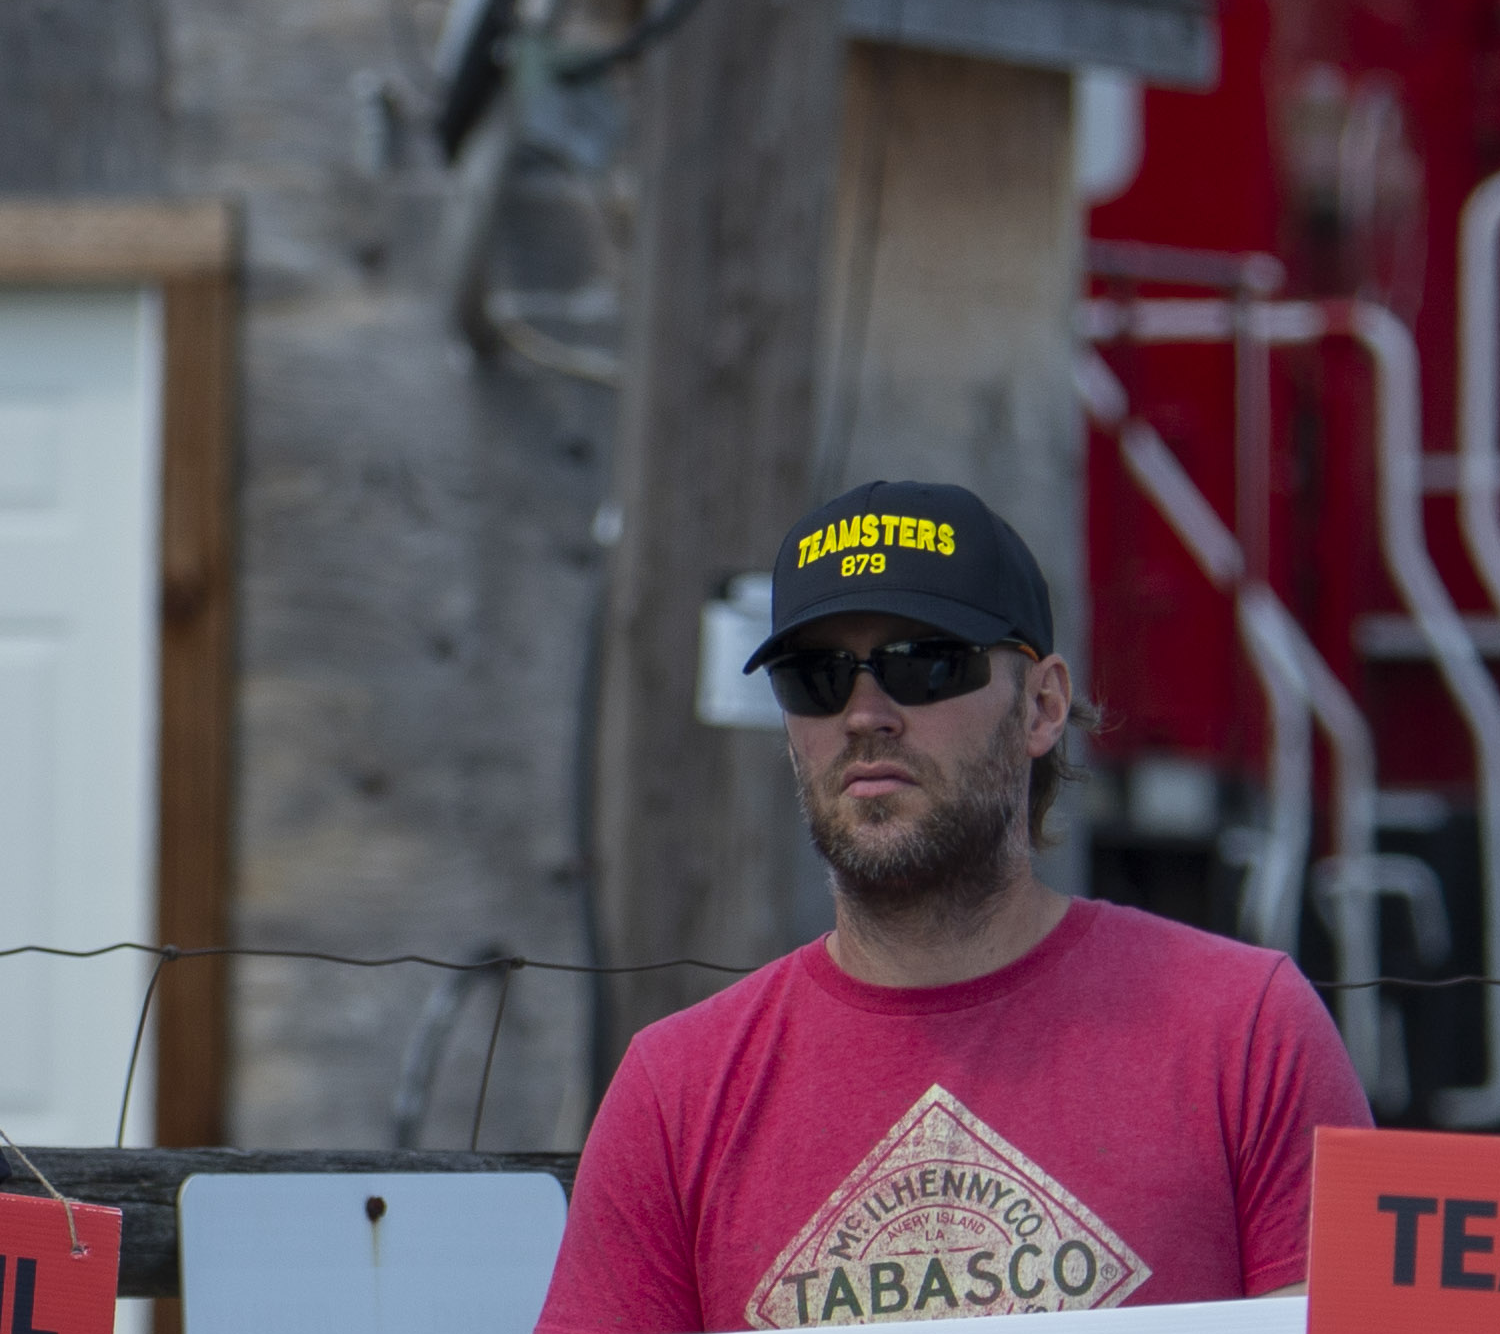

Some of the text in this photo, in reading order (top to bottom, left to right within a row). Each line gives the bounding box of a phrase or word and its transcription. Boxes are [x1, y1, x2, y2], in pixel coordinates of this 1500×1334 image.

[798, 514, 955, 568] TEAMSTERS
[841, 553, 886, 577] 879
[887, 1212, 986, 1242] AVERY ISLAND
[782, 1240, 1097, 1325] TABASCO
